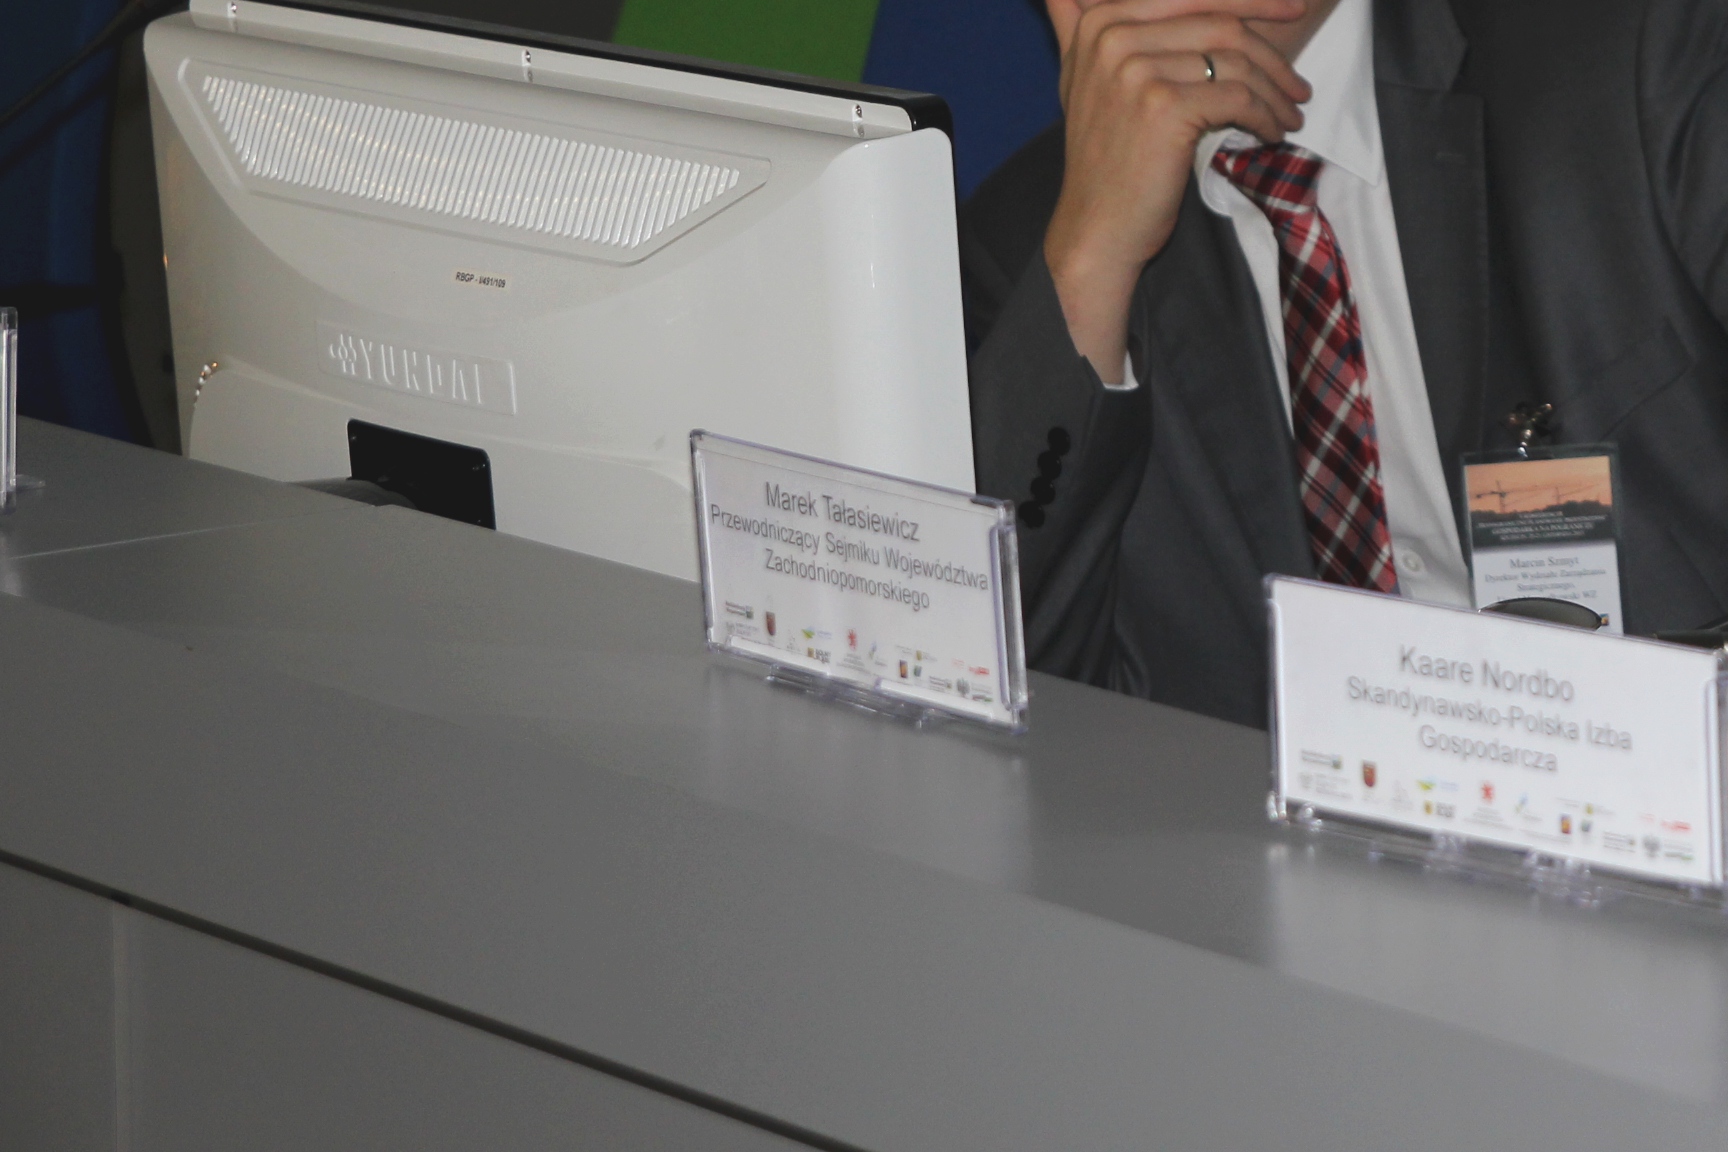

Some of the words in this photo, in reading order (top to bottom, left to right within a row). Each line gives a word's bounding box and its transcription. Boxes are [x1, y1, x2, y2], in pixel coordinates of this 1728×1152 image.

[455, 271, 475, 283] RBGP
[765, 481, 818, 518] Marek
[822, 494, 920, 542] Tałasiewicz
[710, 503, 821, 555] Przewodniczący
[825, 530, 881, 567] Sejmiku
[885, 546, 989, 591] Województwa
[765, 548, 930, 612] Zachodniopomorskiego
[1400, 644, 1474, 684] Kaare
[1482, 659, 1575, 702] Nordbo
[1347, 674, 1581, 742] Skandynawsko-Polska
[1586, 720, 1633, 750] Izba
[1419, 724, 1559, 772] Gospodarcza
